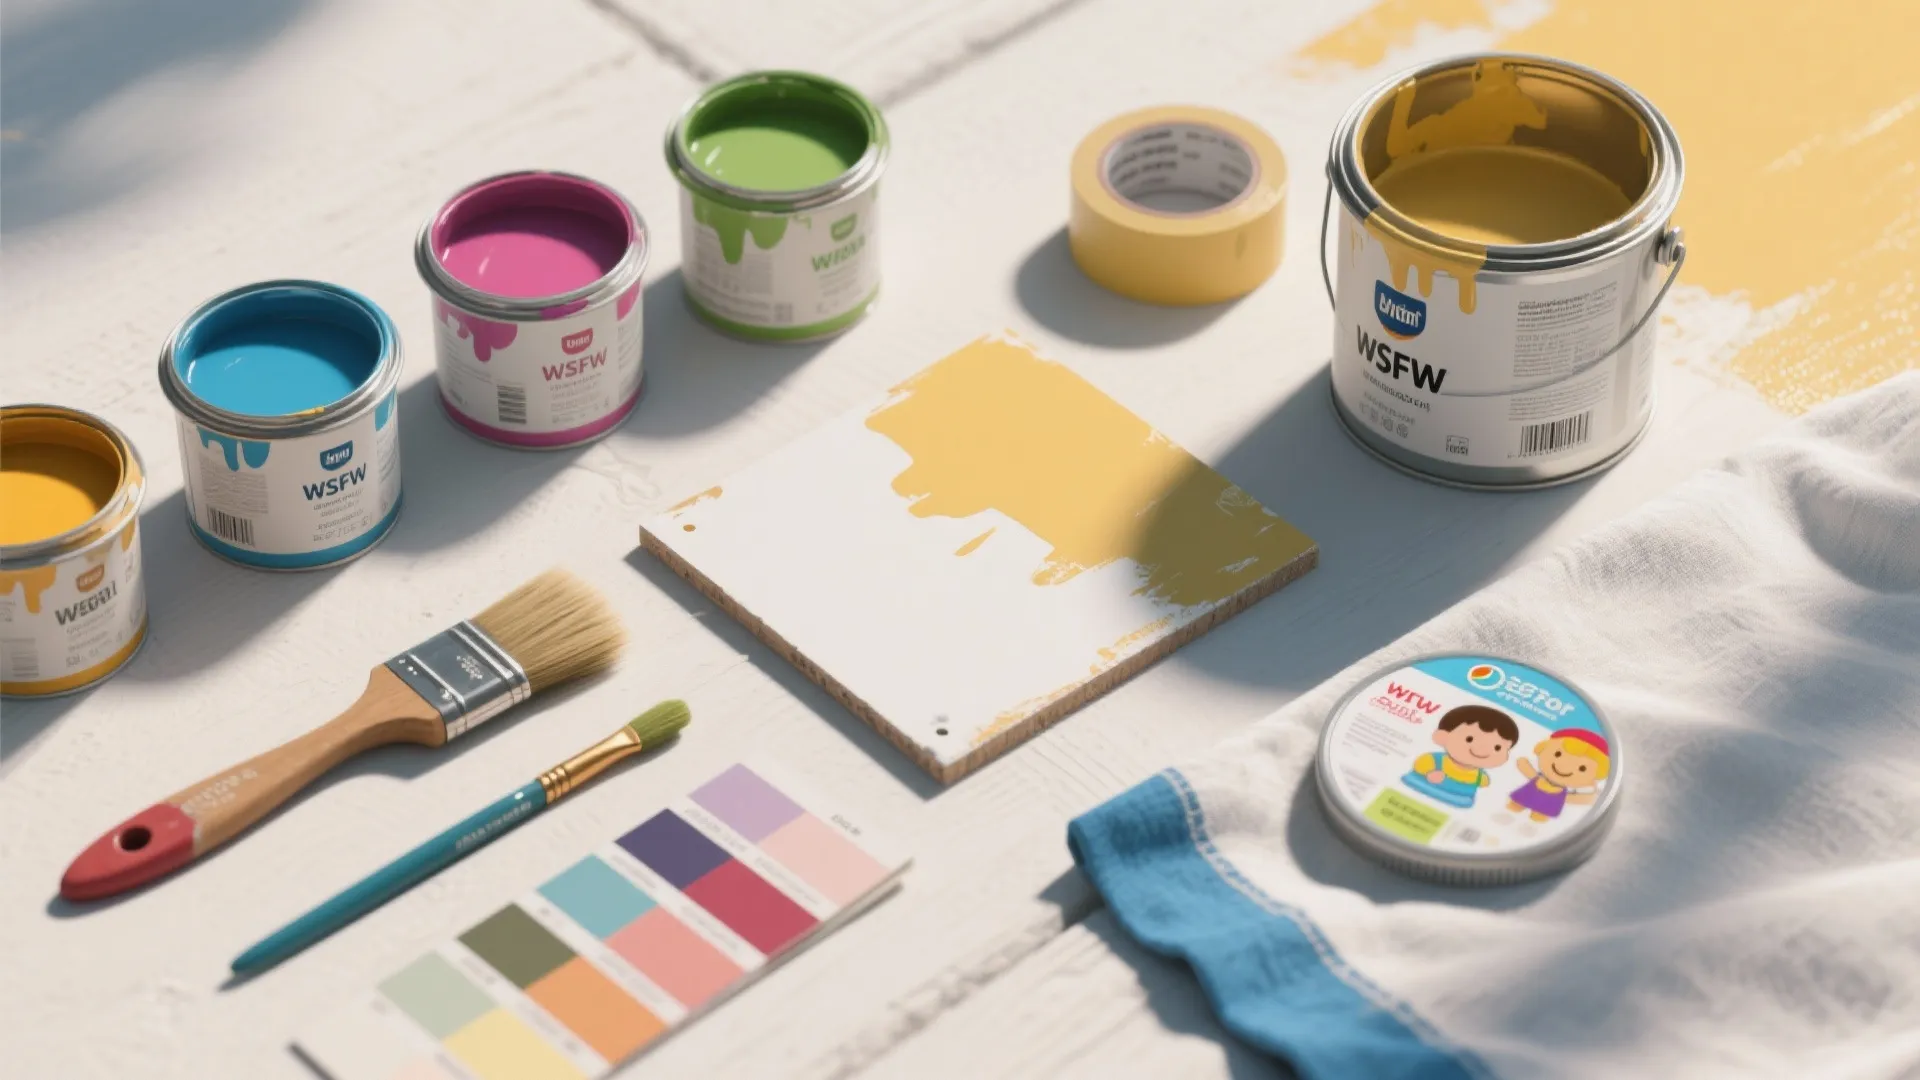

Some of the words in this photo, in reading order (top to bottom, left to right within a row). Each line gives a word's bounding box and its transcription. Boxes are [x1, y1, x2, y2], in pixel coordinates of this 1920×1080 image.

[542, 346, 607, 382] WSFW
[1356, 324, 1447, 394] WSFW
[302, 462, 367, 501] WSFW
